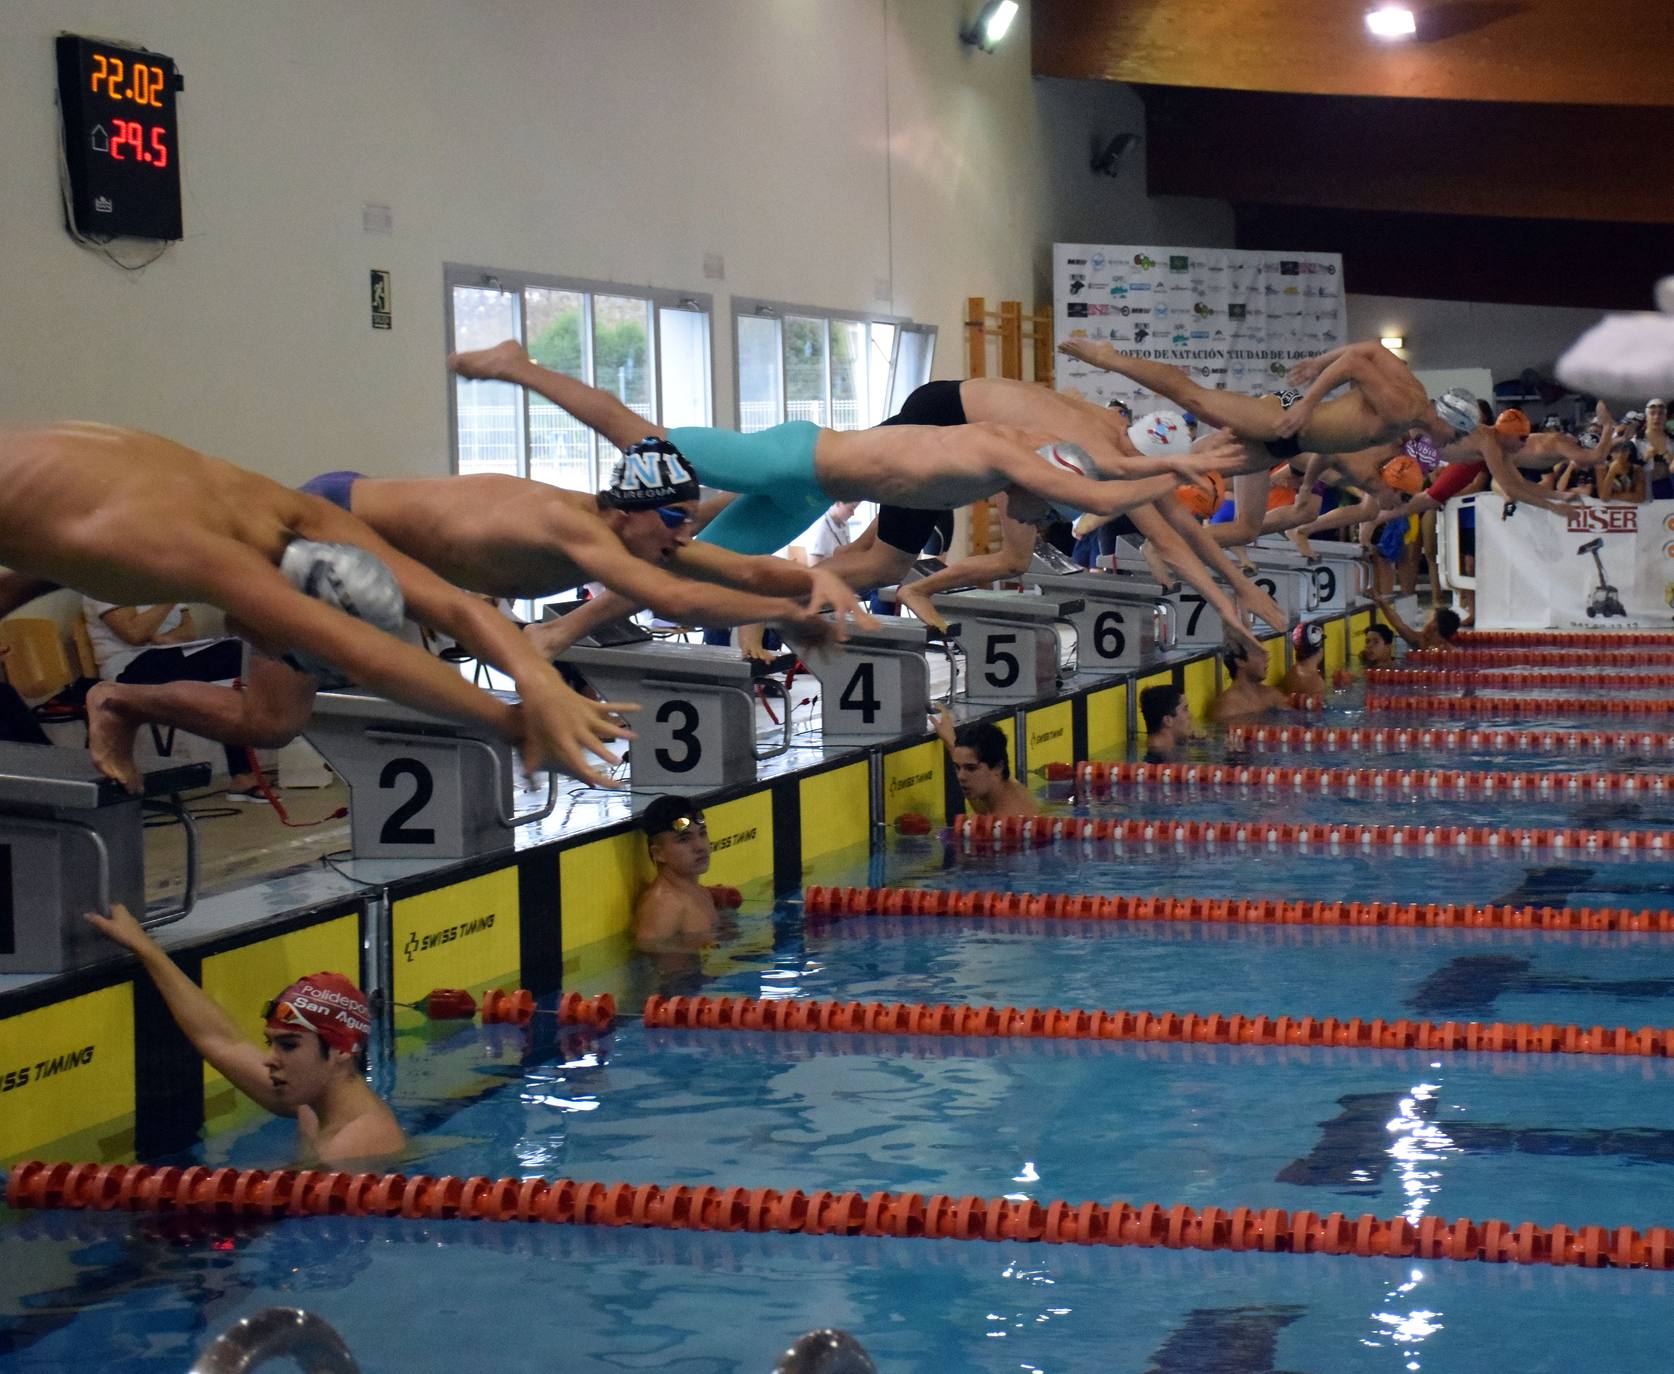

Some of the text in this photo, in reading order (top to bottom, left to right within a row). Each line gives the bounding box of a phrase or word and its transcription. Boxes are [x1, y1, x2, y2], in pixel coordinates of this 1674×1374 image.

[110, 119, 168, 168] 29.5
[1154, 349, 1169, 359] DE
[1170, 346, 1224, 360] NATACIÓN
[1271, 349, 1285, 359] DE
[1312, 566, 1336, 603] 9
[1093, 611, 1126, 659] 6
[1179, 595, 1208, 636] 7
[984, 634, 1020, 688] 5
[839, 662, 881, 724] 4
[655, 699, 702, 773] 3
[379, 757, 436, 844] 2
[421, 914, 495, 951] SWISS TIMING
[293, 996, 330, 1016] San
[35, 1045, 94, 1082] TIMING
